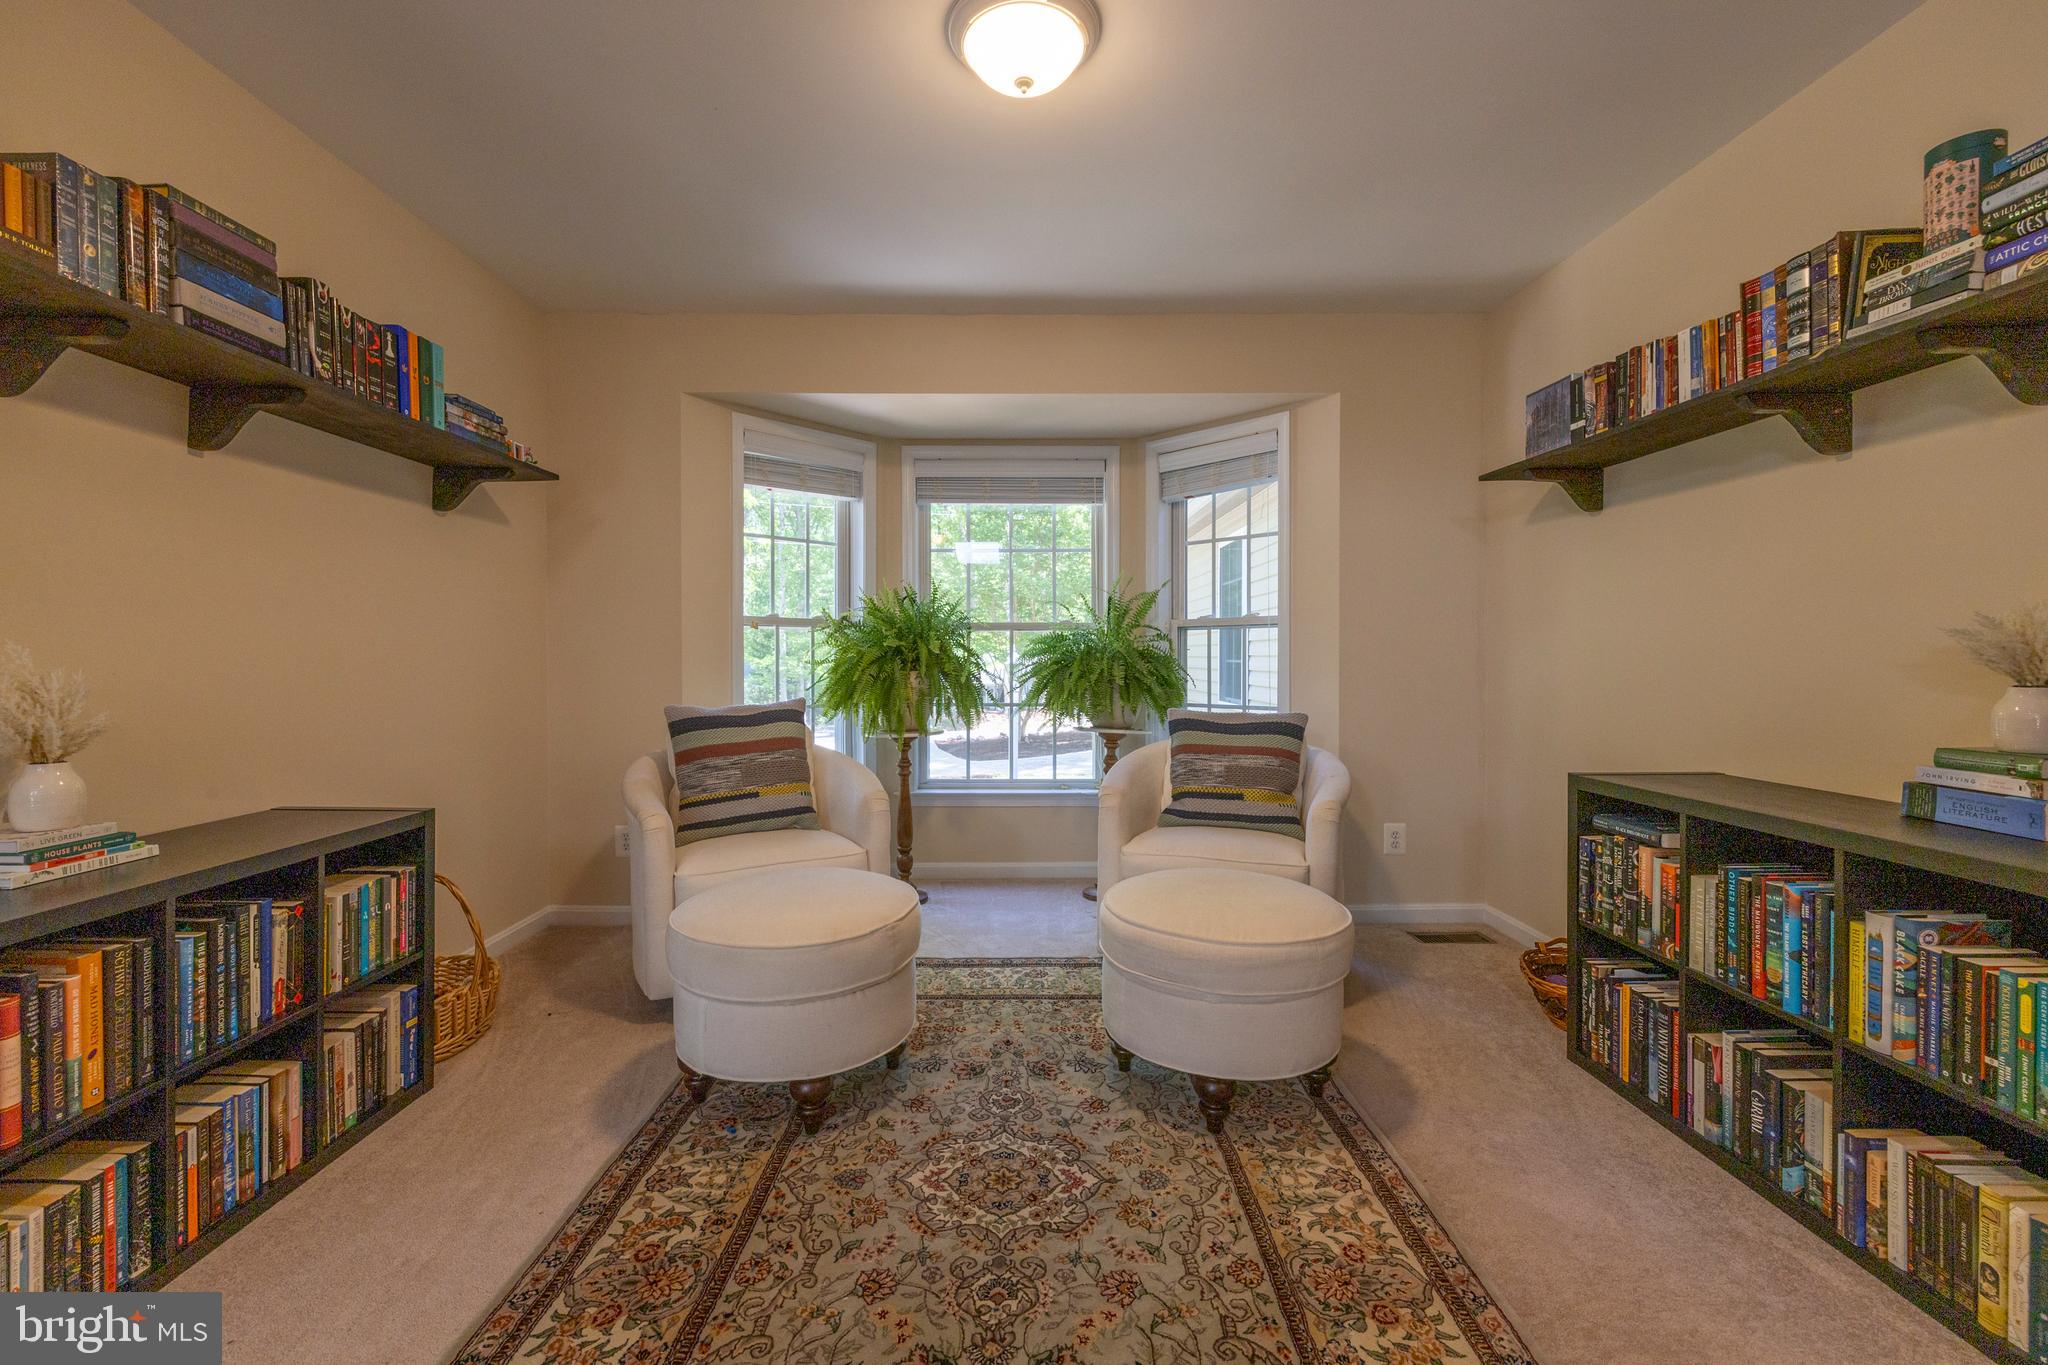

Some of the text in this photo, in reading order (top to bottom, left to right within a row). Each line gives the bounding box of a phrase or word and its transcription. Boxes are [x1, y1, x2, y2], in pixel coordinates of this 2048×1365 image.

[2020, 152, 2048, 177] CLOIS
[1992, 203, 2017, 219] WILD
[1995, 241, 2030, 263] ATTIC
[1879, 286, 1913, 304] BROWN
[1887, 280, 1908, 295] DAN
[1920, 771, 1943, 780] JOHN
[1946, 775, 1977, 785] IRVING
[1943, 808, 2009, 824] LITERATURE
[1951, 801, 2000, 815] ENGLISH
[39, 832, 83, 846] LIVE GREEN
[43, 847, 71, 860] HOUSE
[72, 840, 102, 852] PLANTS
[61, 862, 82, 876] WILD
[98, 854, 120, 868] HOME
[197, 939, 205, 959] THE
[1851, 926, 1860, 971] HIMSELF
[113, 947, 125, 998] SCHWAB
[1895, 929, 1906, 996] BLACK CAKE
[143, 942, 151, 1010] MINDHUNTER
[197, 973, 205, 995] WIFE
[50, 986, 58, 1030] PORTOBELLO
[89, 984, 99, 1047] MAD HONEY
[114, 1012, 126, 1054] ADDIE
[52, 1028, 63, 1111] PAULO COELHO
[1657, 1025, 1668, 1098] NINTH HOUSE
[2020, 1052, 2029, 1105] JENNY COLGAN
[1751, 1087, 1765, 1138] CARAVAL
